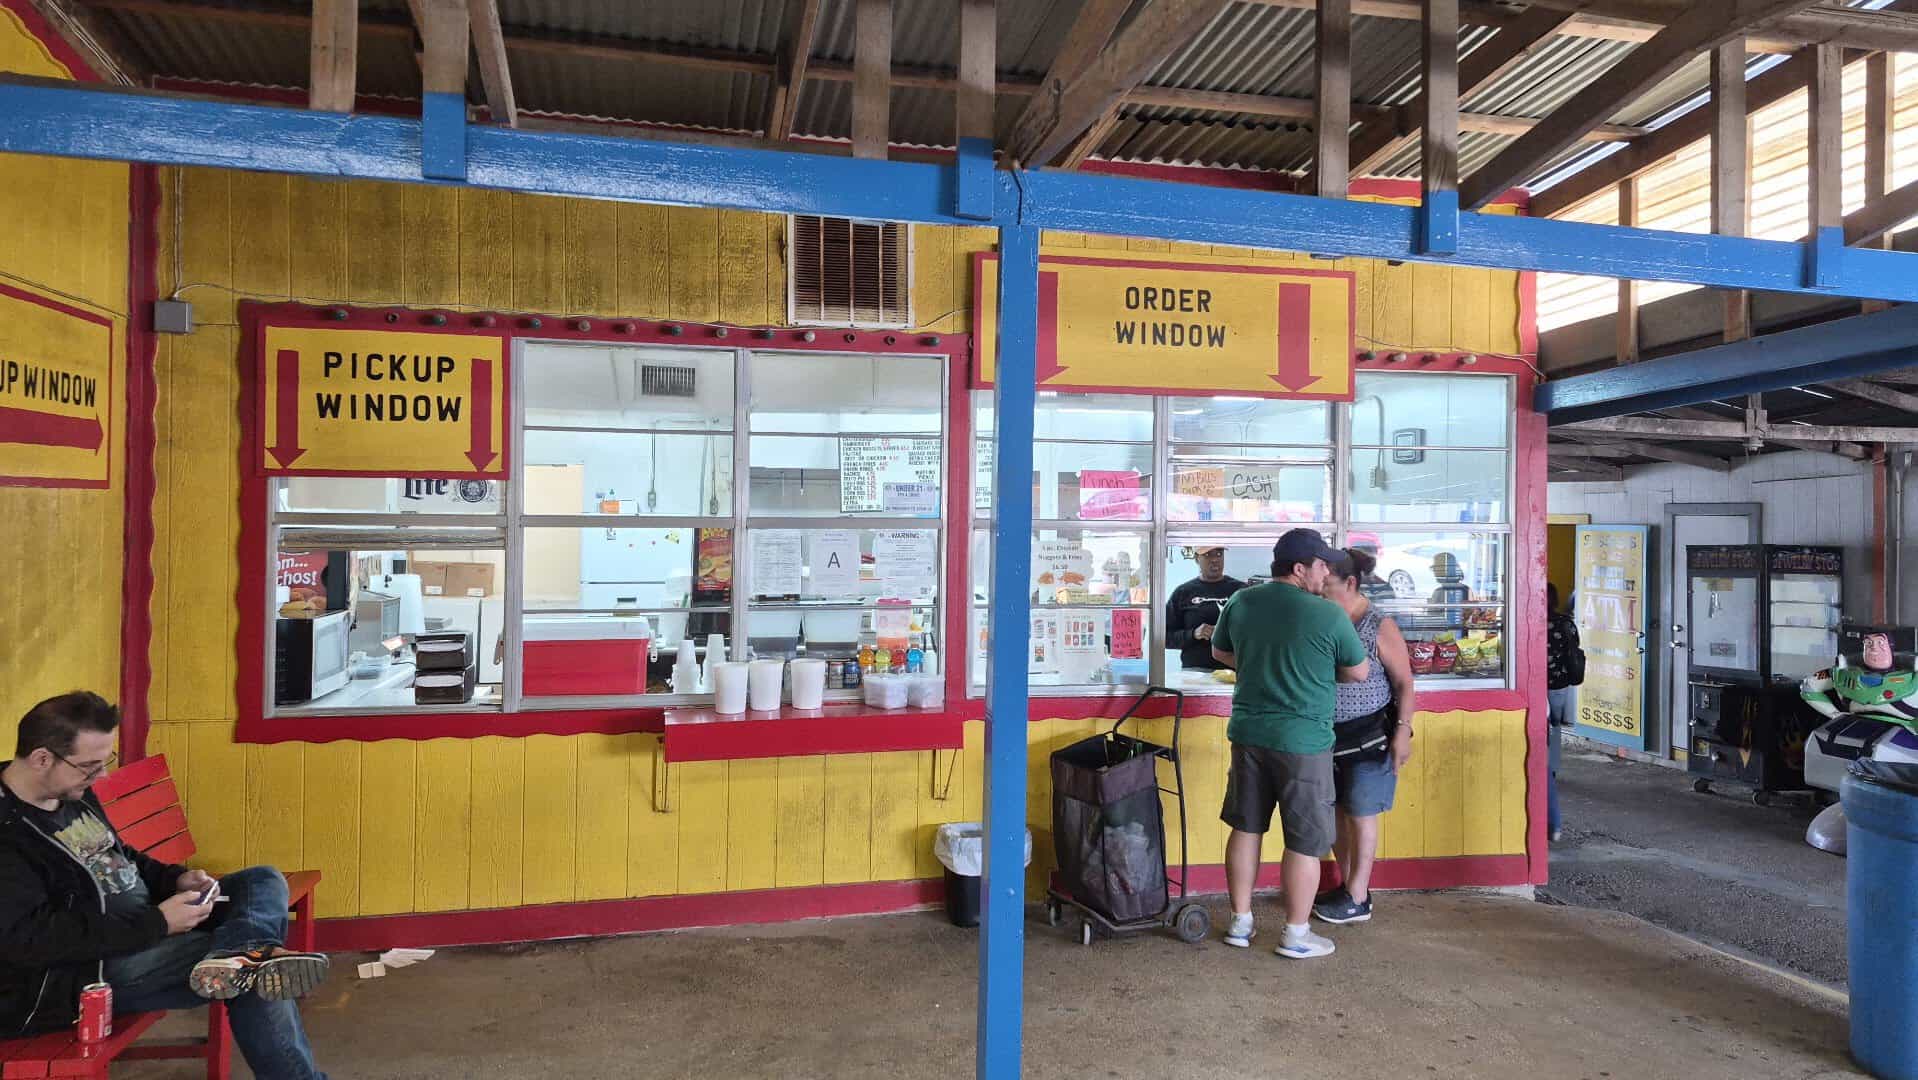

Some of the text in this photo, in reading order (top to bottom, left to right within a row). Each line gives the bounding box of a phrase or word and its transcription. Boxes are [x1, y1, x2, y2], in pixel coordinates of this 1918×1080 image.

[1125, 286, 1212, 313] ORDER
[1115, 320, 1226, 348] WINDOW
[323, 351, 456, 382] PICKUP
[23, 364, 96, 407] WINDOW
[316, 393, 462, 422] WINDOW
[403, 478, 449, 500] Lite
[1232, 473, 1273, 496] CASH
[827, 551, 841, 568] A
[1582, 597, 1638, 633] ATM
